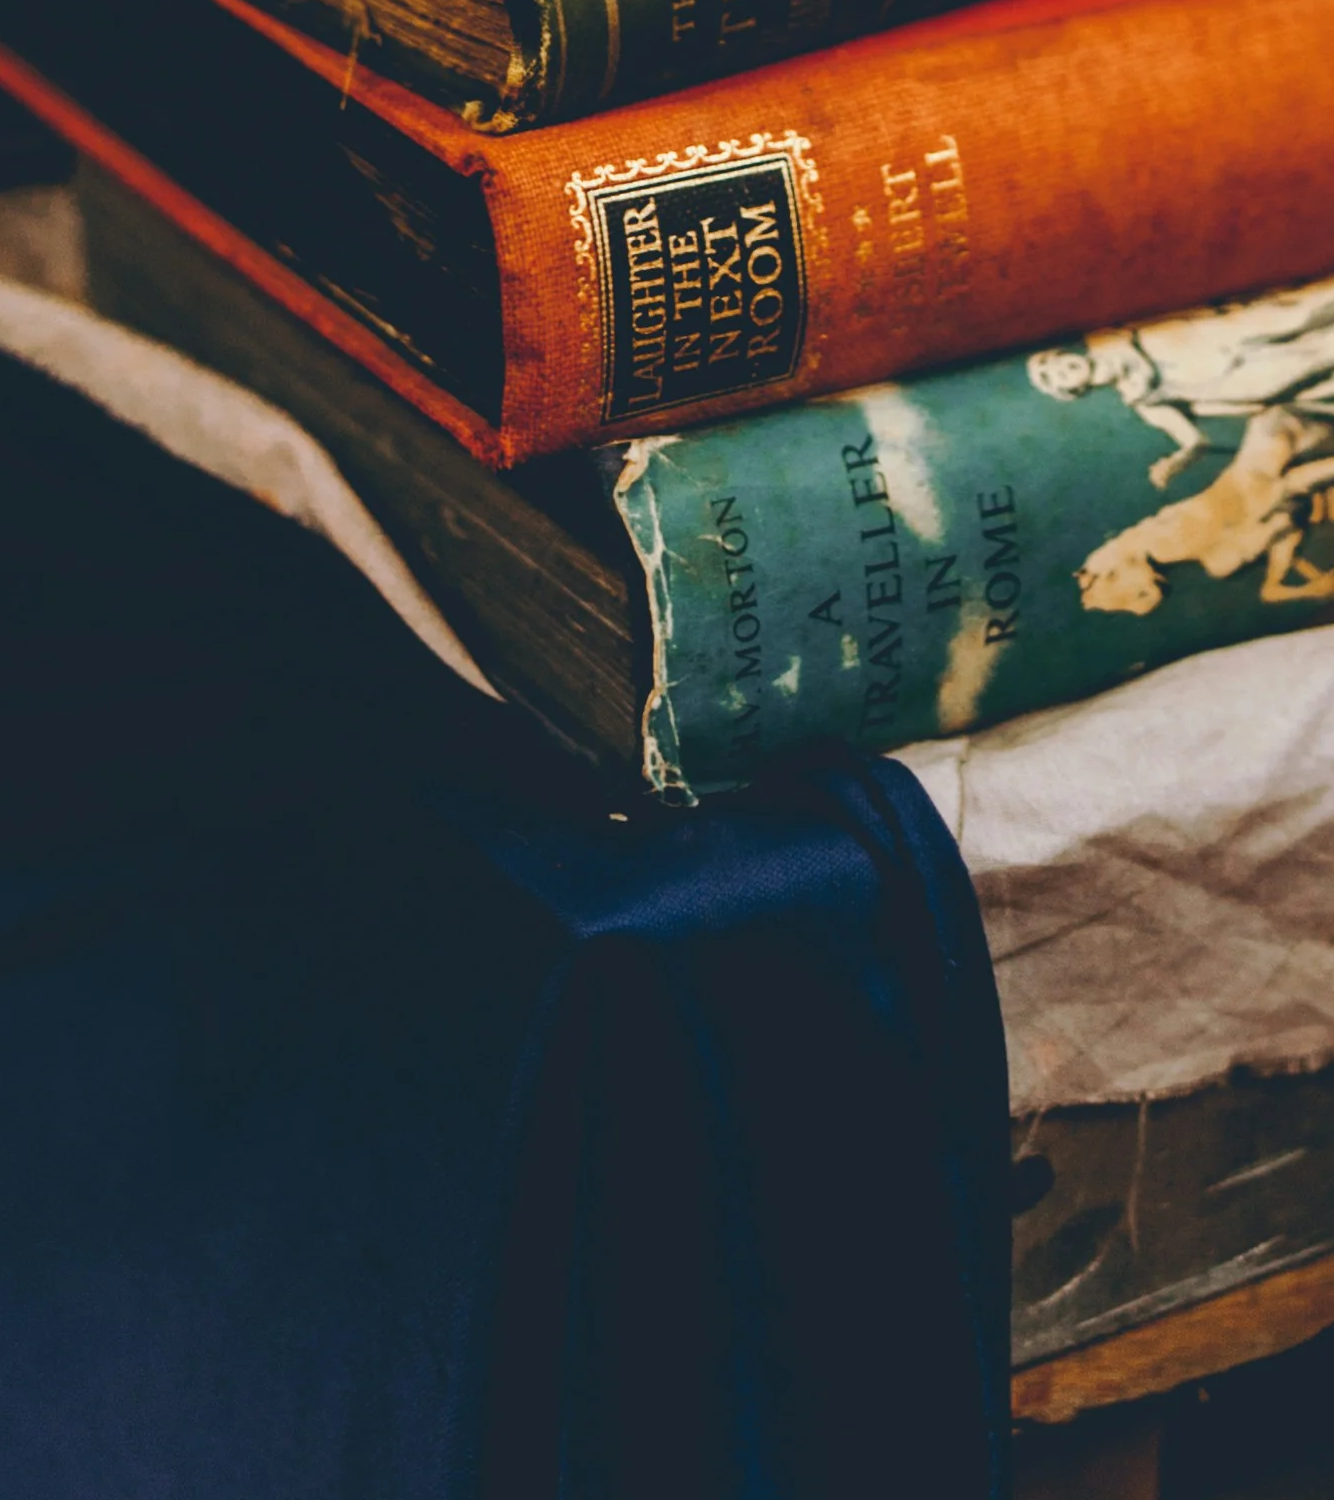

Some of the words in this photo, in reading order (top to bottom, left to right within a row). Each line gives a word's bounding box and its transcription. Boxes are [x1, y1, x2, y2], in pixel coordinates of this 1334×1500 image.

[622, 197, 664, 405] LAUGHTER
[668, 228, 701, 323] THE
[701, 217, 743, 367] NEXT
[744, 200, 785, 361] ROOM
[673, 333, 702, 374] IN
[709, 495, 763, 679] MORTON
[806, 590, 843, 628] A
[839, 431, 904, 738] TRAVELLER
[924, 553, 962, 615] IN
[976, 484, 1022, 645] ROME
